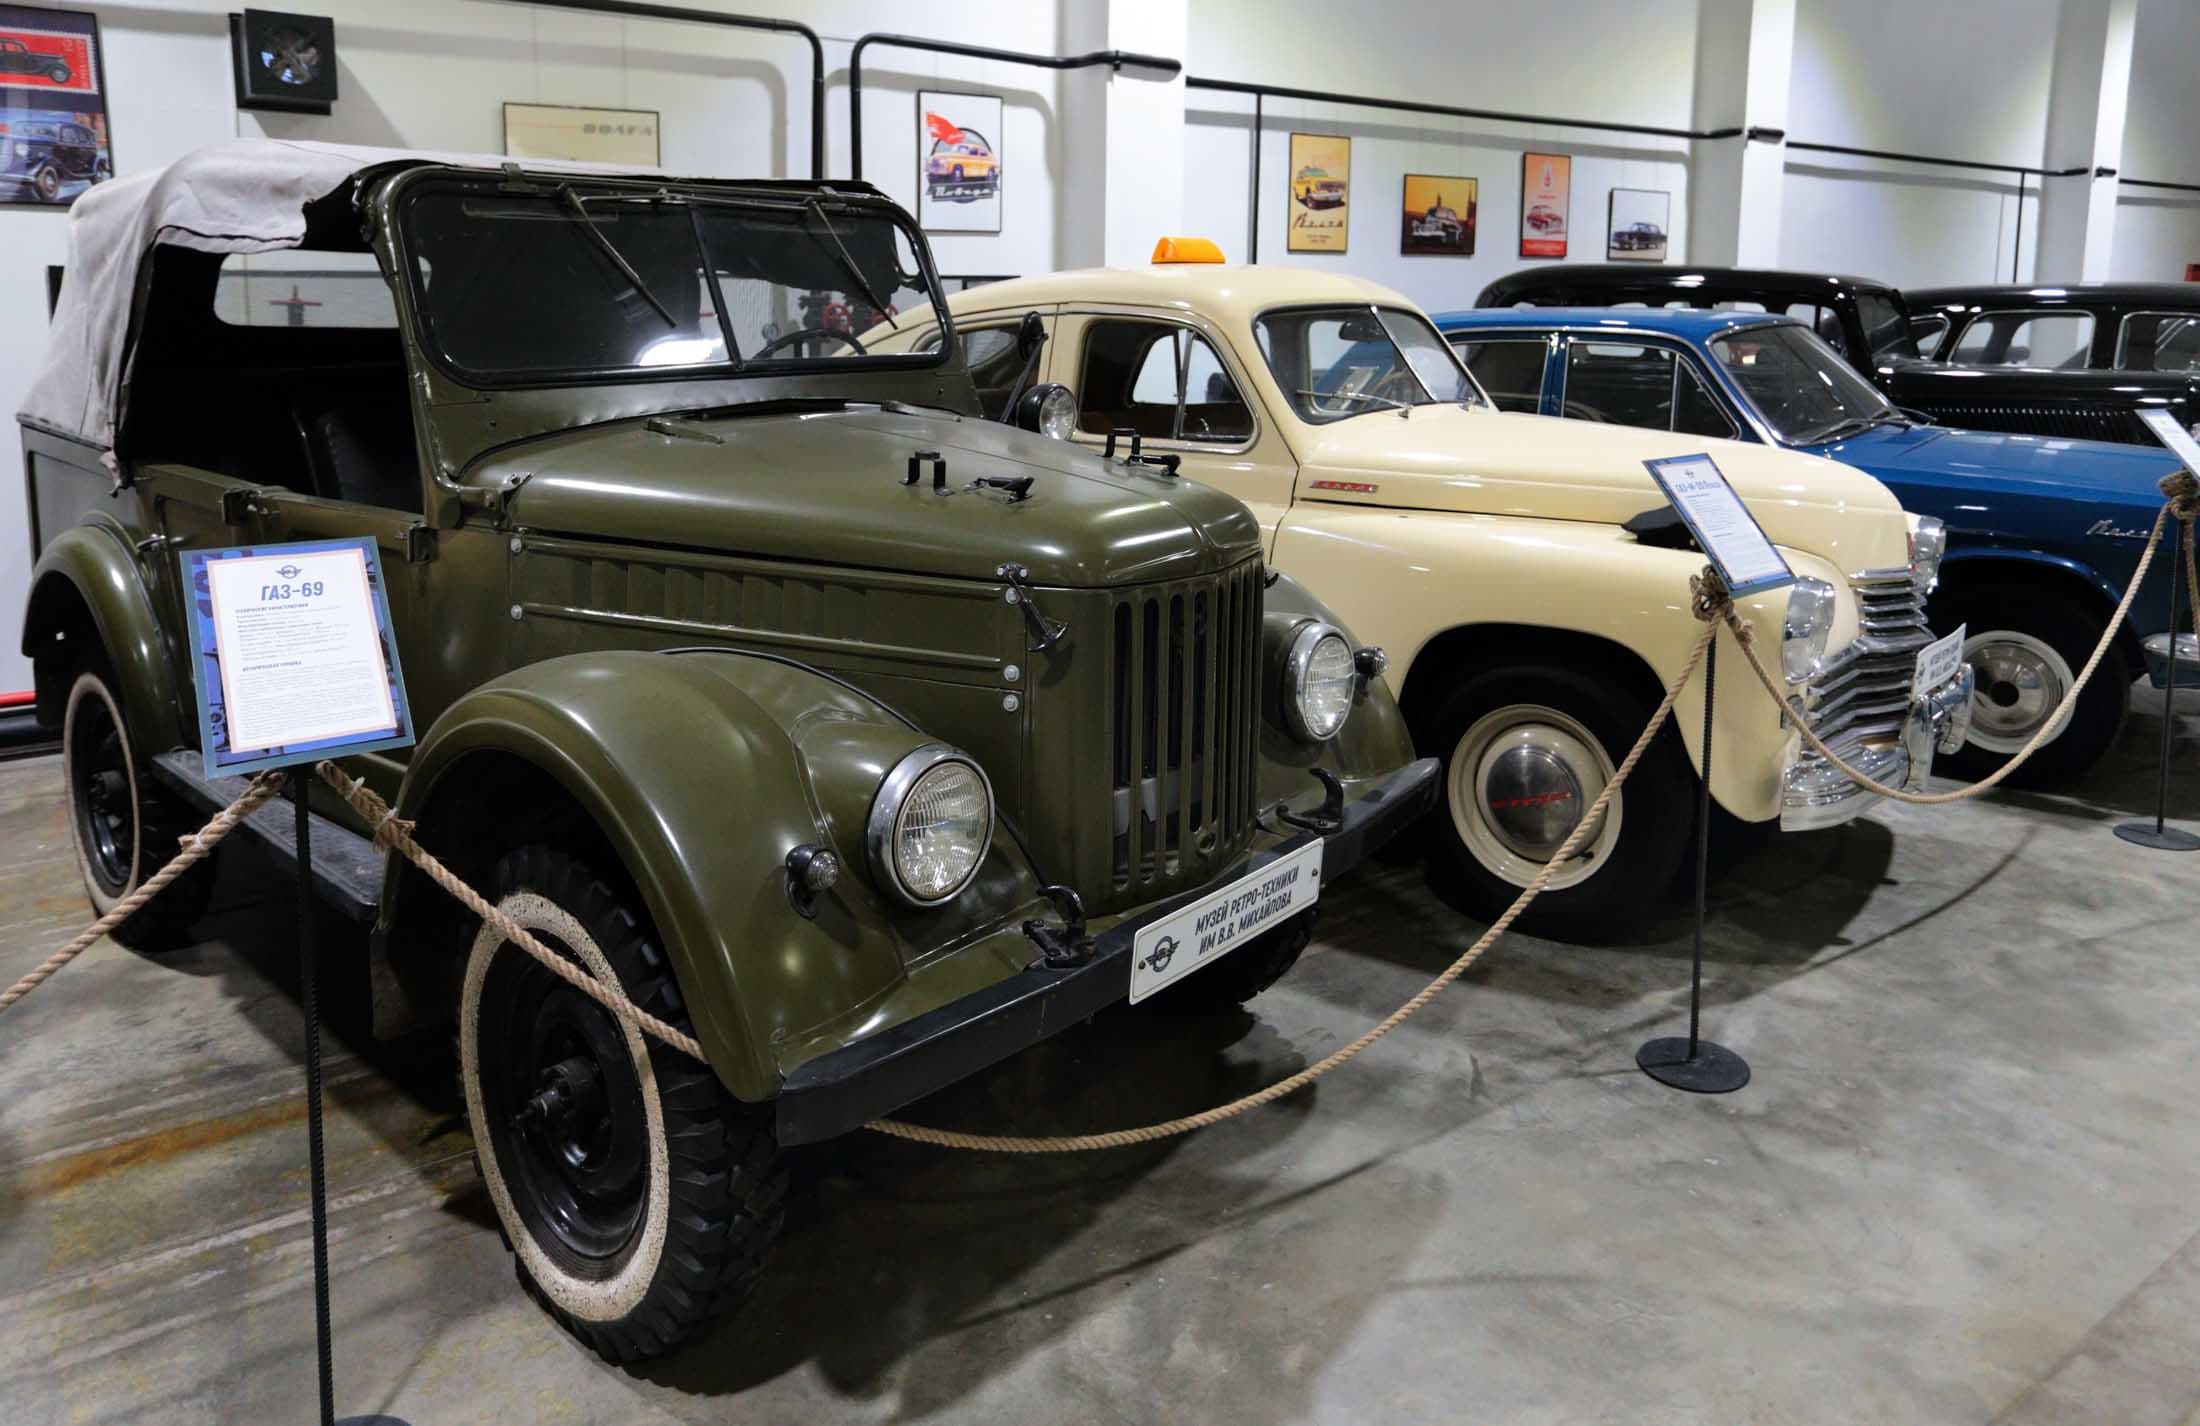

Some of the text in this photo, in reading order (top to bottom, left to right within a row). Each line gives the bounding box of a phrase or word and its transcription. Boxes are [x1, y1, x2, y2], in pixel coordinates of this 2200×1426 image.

[261, 581, 324, 601] ГАЗ-69
[1195, 866, 1300, 936] МУЗЕЙ РЕТРО-ТЕХНИКИ
[1198, 890, 1292, 956] ИМ В.В. МИХАЙЛОВА
